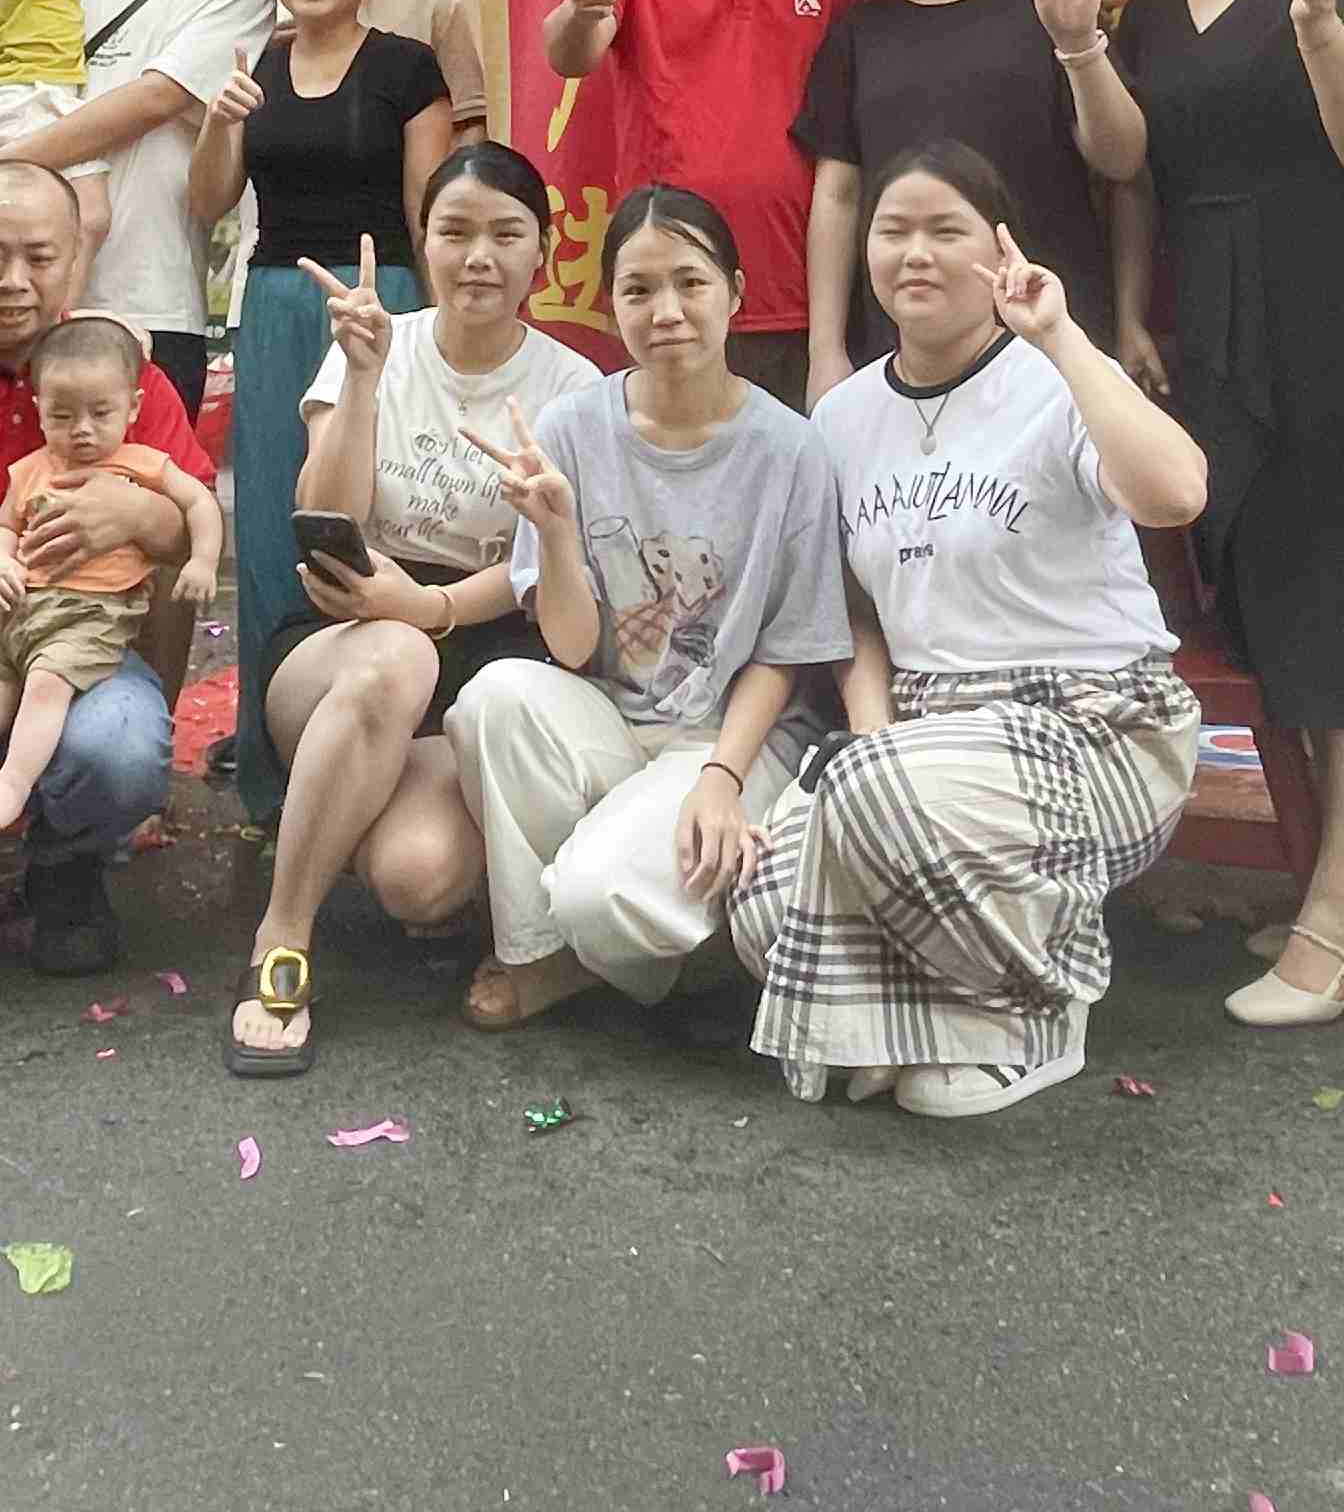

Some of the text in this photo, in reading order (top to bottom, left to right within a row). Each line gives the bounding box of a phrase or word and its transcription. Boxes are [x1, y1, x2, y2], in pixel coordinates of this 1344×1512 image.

[376, 456, 505, 508] small town lif
[407, 491, 460, 521] make
